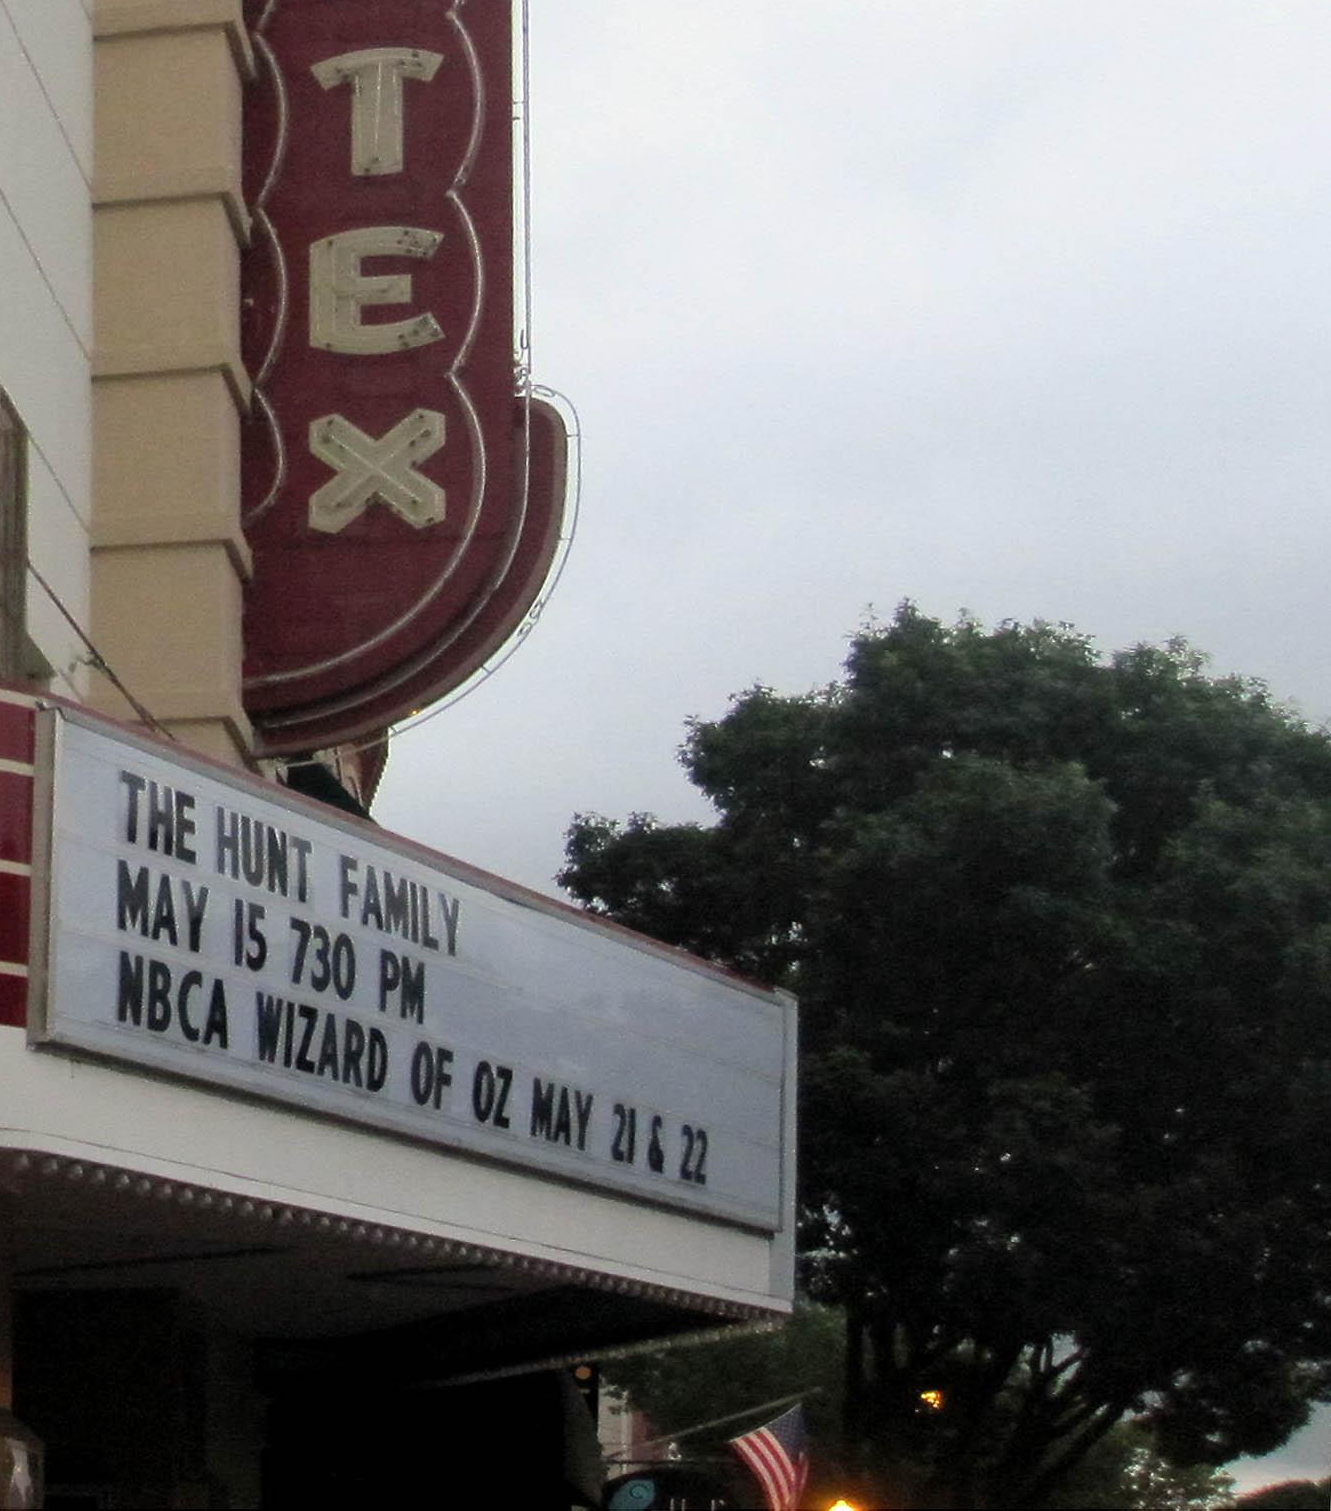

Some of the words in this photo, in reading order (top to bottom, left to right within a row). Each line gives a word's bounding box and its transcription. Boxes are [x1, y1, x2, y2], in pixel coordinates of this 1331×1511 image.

[117, 858, 210, 954] MAY
[233, 898, 268, 972] 15
[289, 916, 356, 1001] 730
[378, 948, 426, 1025] PM
[118, 769, 197, 866] THE
[216, 806, 313, 904] HUNT
[339, 853, 460, 957] FAMILY
[117, 950, 229, 1049] NBCA
[256, 991, 388, 1092] WIZARD
[410, 1040, 454, 1110] OF
[472, 1060, 514, 1129] OZ
[529, 1076, 594, 1151] MAY
[610, 1103, 637, 1165] 21
[647, 1114, 665, 1174] &
[679, 1124, 708, 1185] 22
